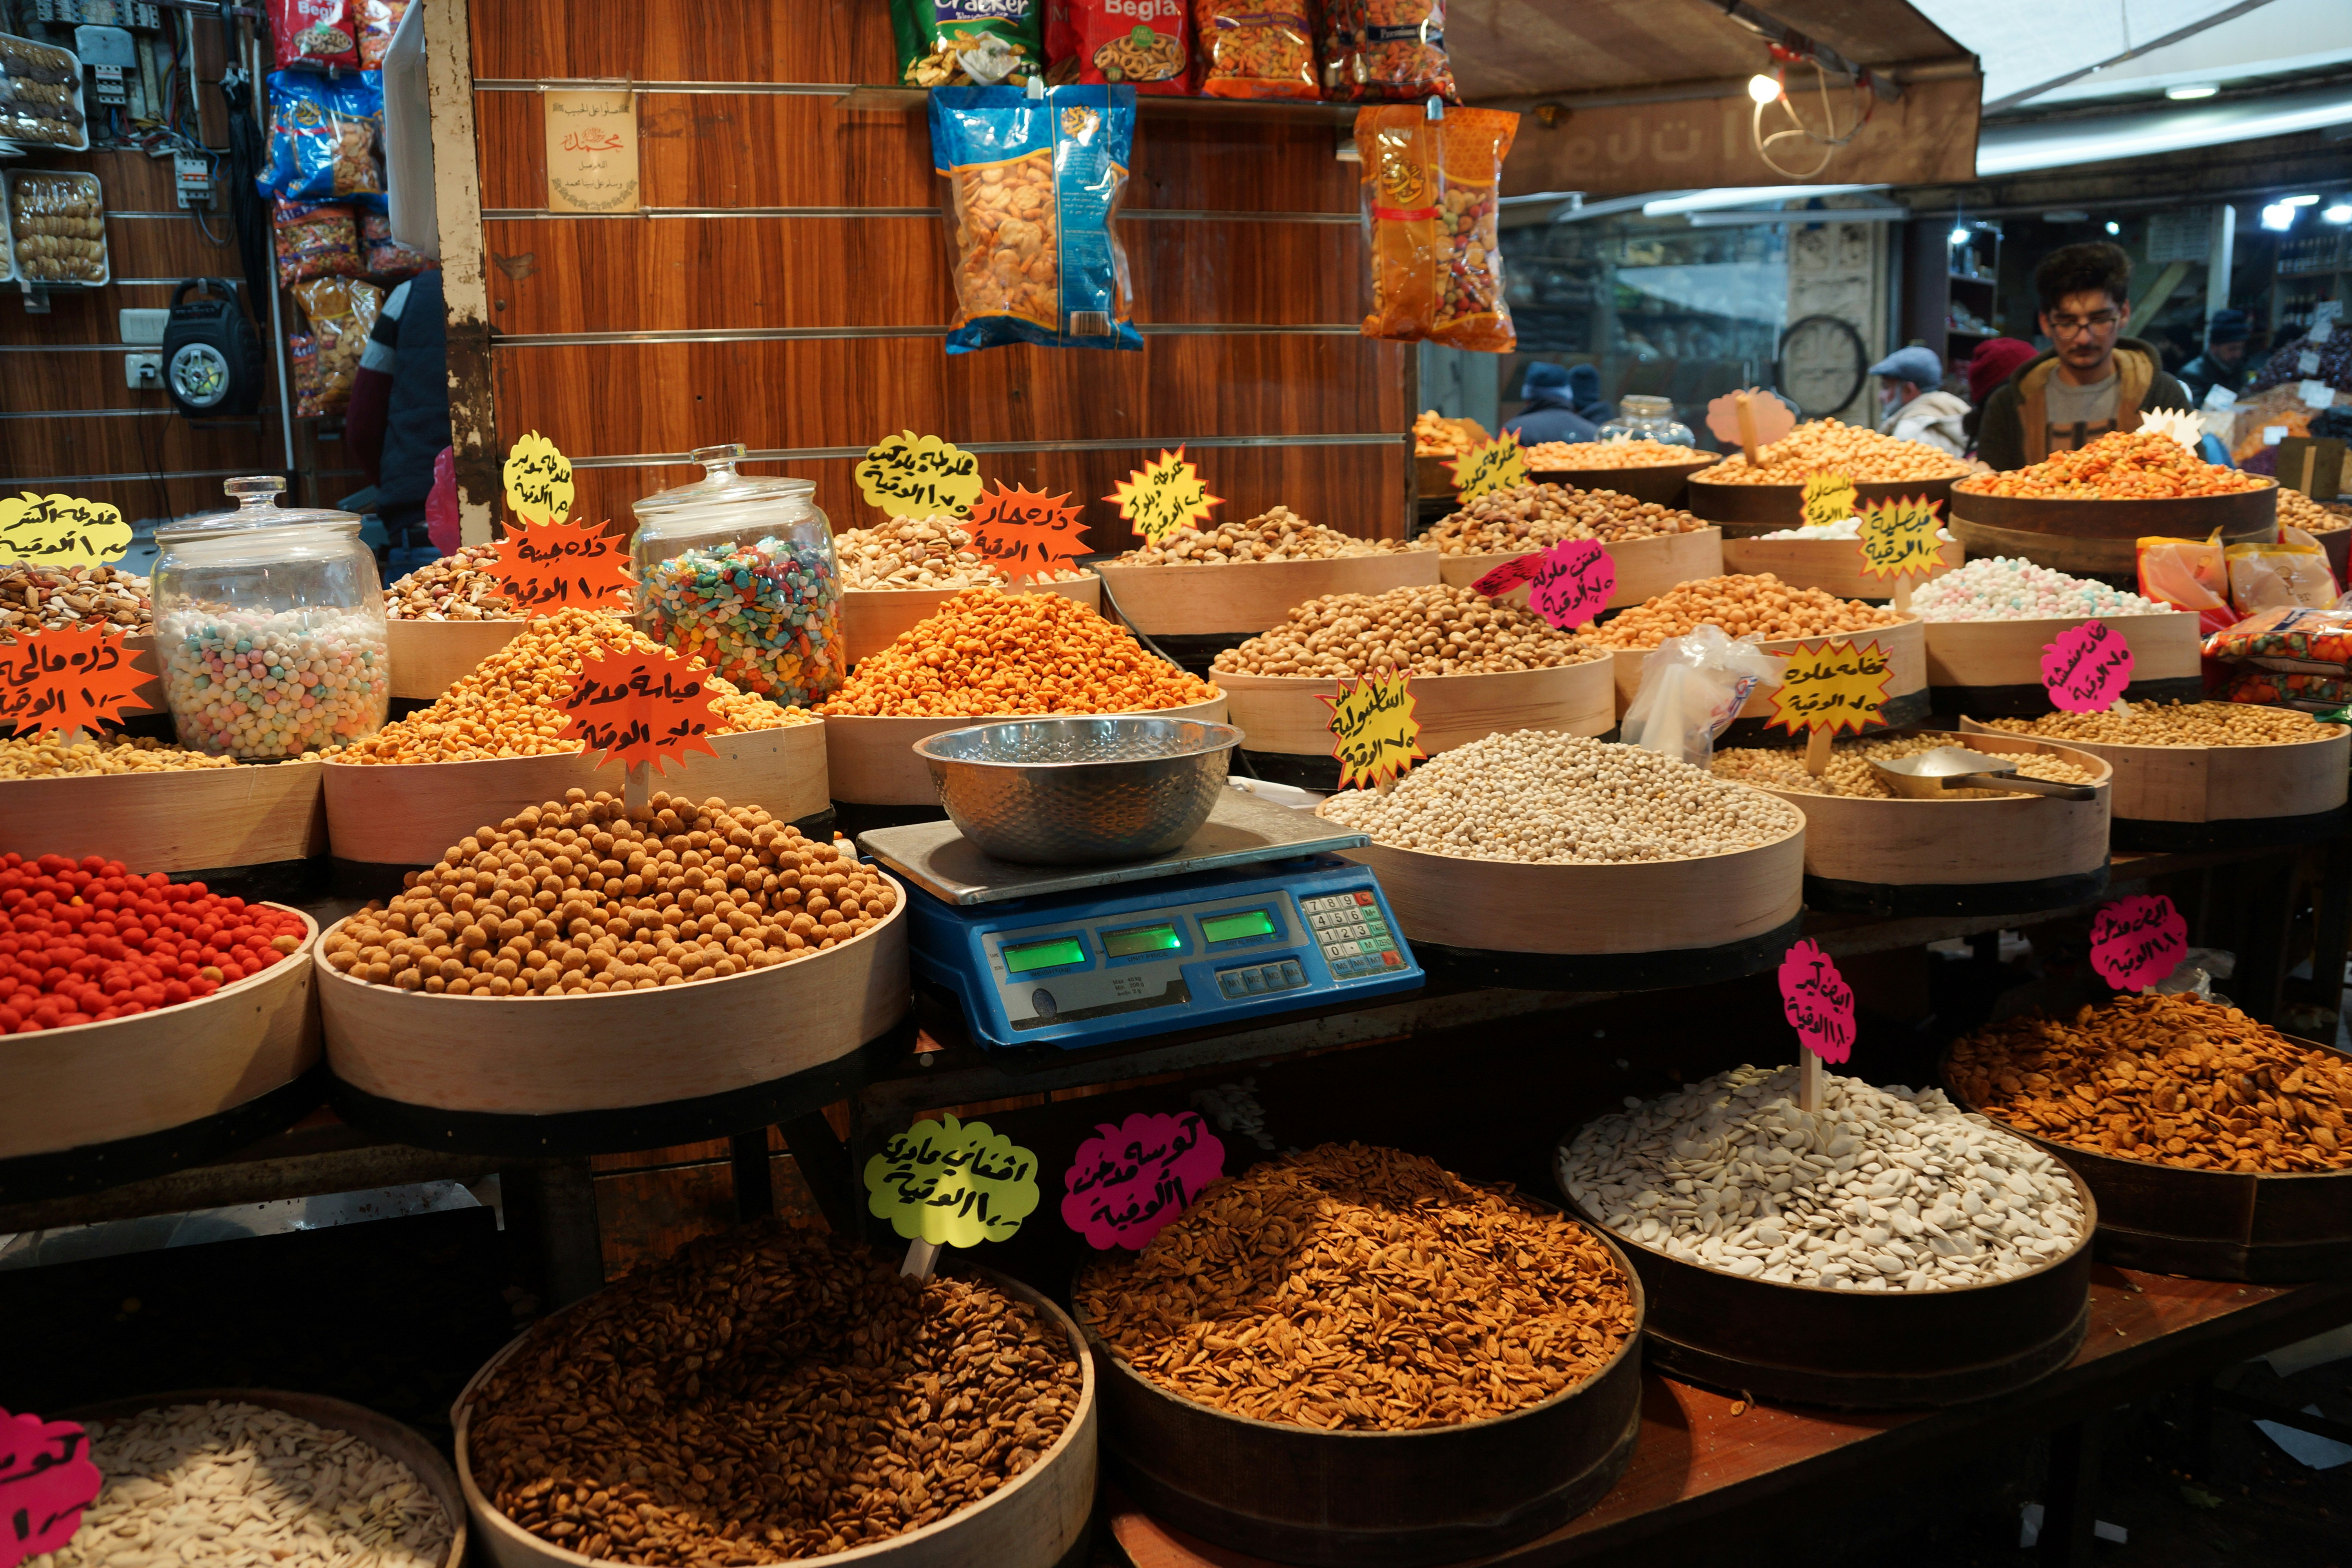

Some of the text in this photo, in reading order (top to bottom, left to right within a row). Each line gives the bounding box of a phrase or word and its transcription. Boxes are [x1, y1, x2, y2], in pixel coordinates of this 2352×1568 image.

[298, 1, 336, 20] Begl
[1309, 901, 1317, 910] 7
[1327, 898, 1335, 907] 8
[1344, 896, 1352, 905] 9
[1318, 916, 1326, 925] 4
[1335, 913, 1342, 922] 5
[1351, 911, 1359, 920] 6
[1325, 931, 1332, 940] 1
[1341, 929, 1350, 938] 2
[1357, 926, 1366, 935] 3
